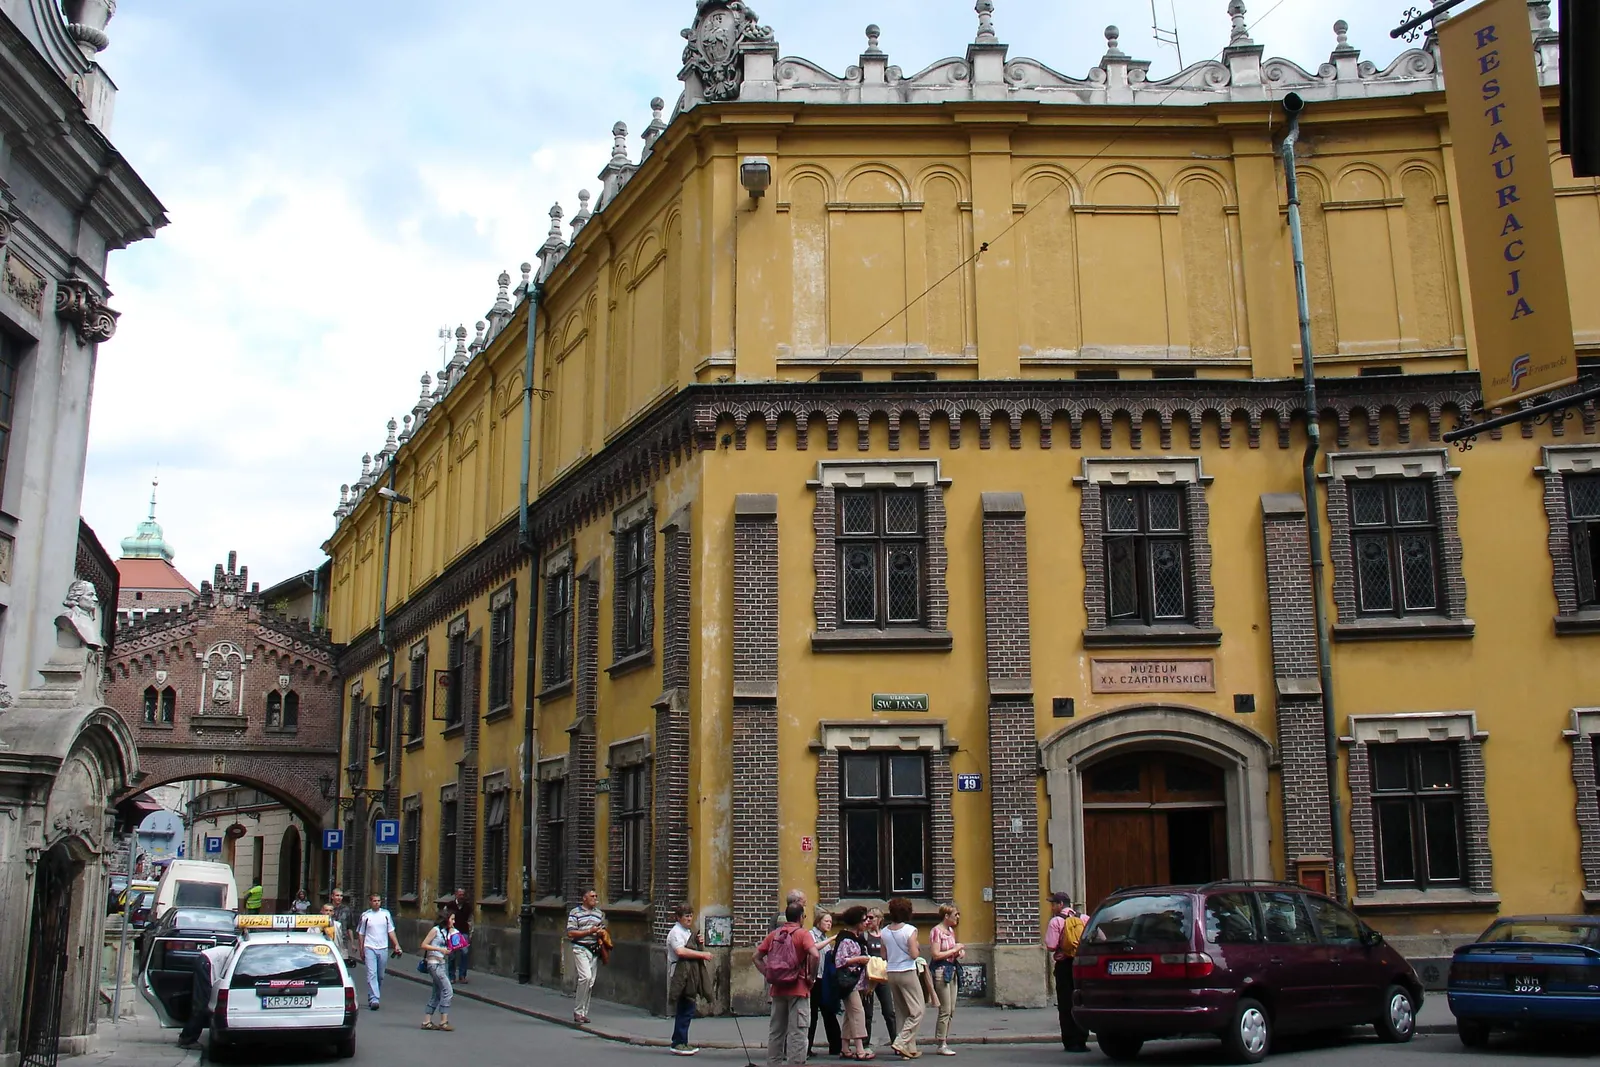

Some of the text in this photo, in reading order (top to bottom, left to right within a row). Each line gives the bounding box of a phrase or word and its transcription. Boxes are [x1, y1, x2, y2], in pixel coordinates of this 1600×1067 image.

[1474, 24, 1534, 320] RESTAURACJA
[1130, 665, 1177, 673] MUZEUM
[1101, 675, 1207, 685] XX. CZARTORYSKICH
[896, 700, 923, 709] JANA
[964, 780, 976, 789] 19
[381, 823, 395, 841] P
[209, 838, 219, 851] P
[327, 832, 340, 847] P
[275, 916, 293, 924] TAXI
[1113, 962, 1124, 972] KR
[1514, 985, 1541, 993] 3079
[267, 996, 310, 1006] KR 57825
